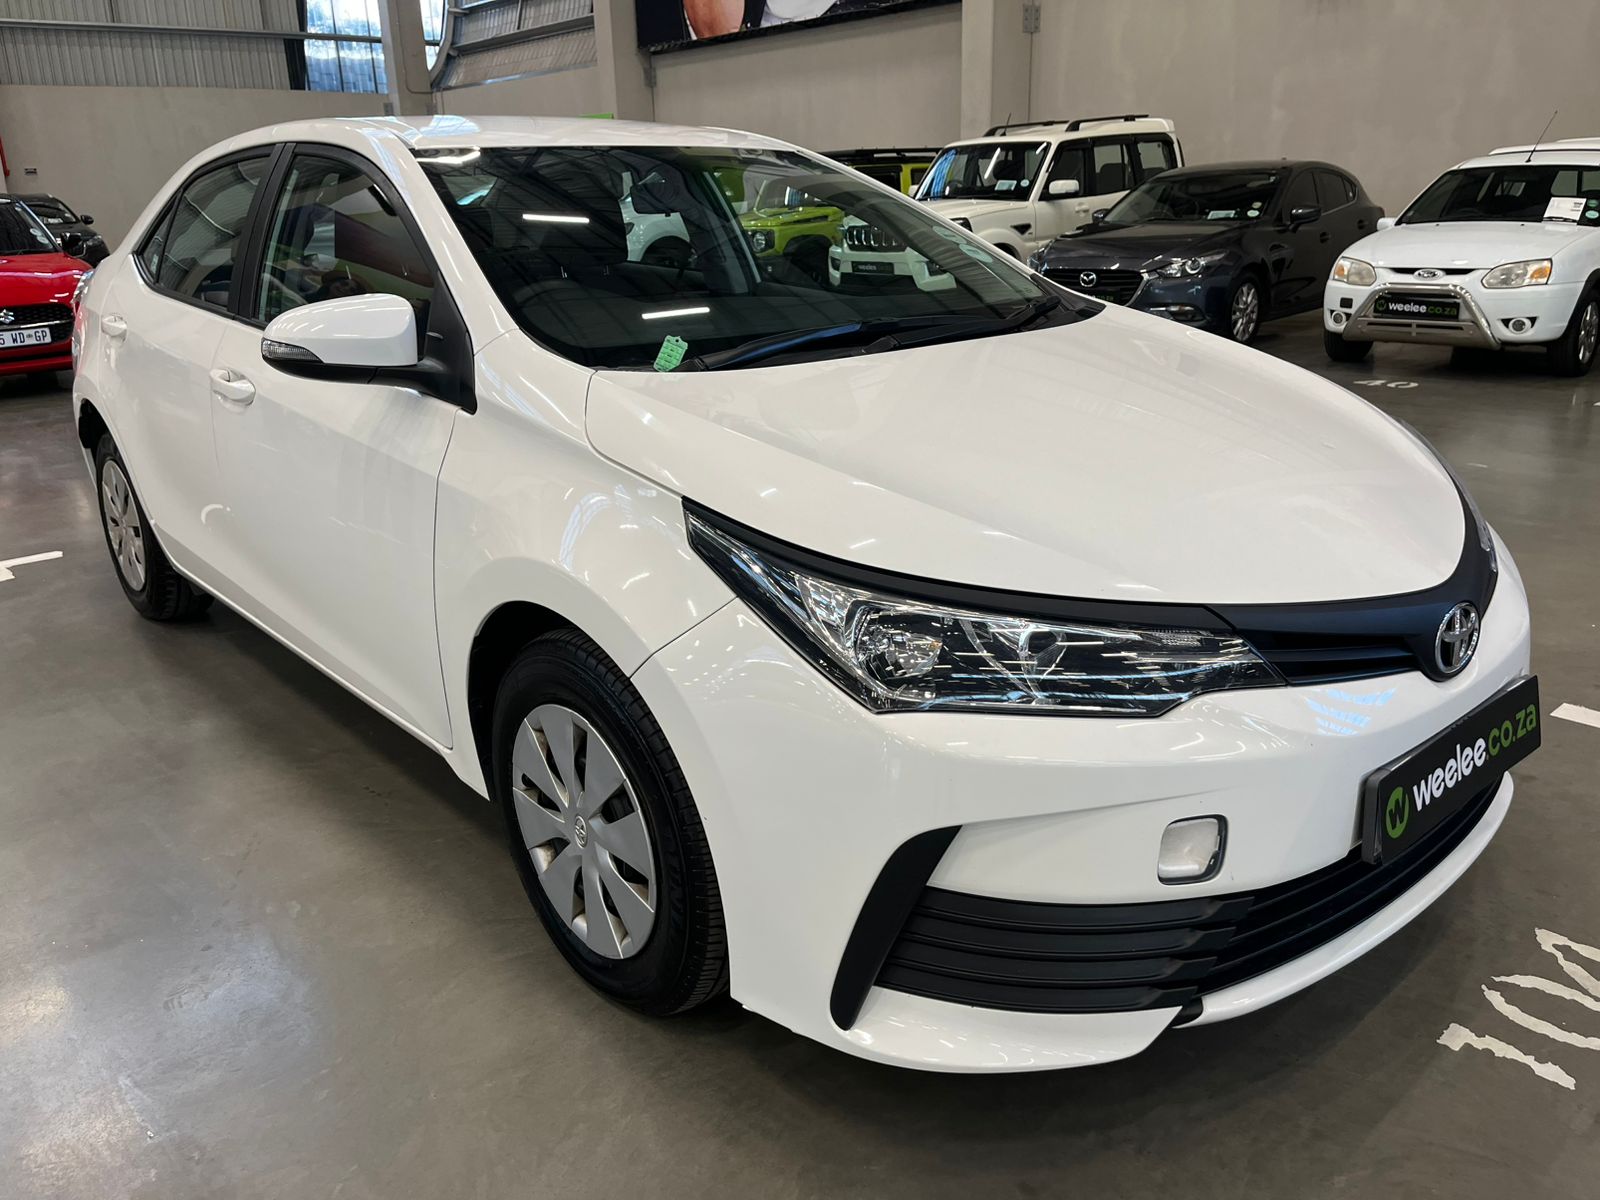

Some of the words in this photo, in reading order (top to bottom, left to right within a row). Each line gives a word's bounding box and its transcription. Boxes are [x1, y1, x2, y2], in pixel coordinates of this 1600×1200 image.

[11, 331, 26, 344] WD
[34, 330, 47, 342] GP
[1353, 380, 1419, 389] 40
[1412, 703, 1537, 812] weelee.co.za
